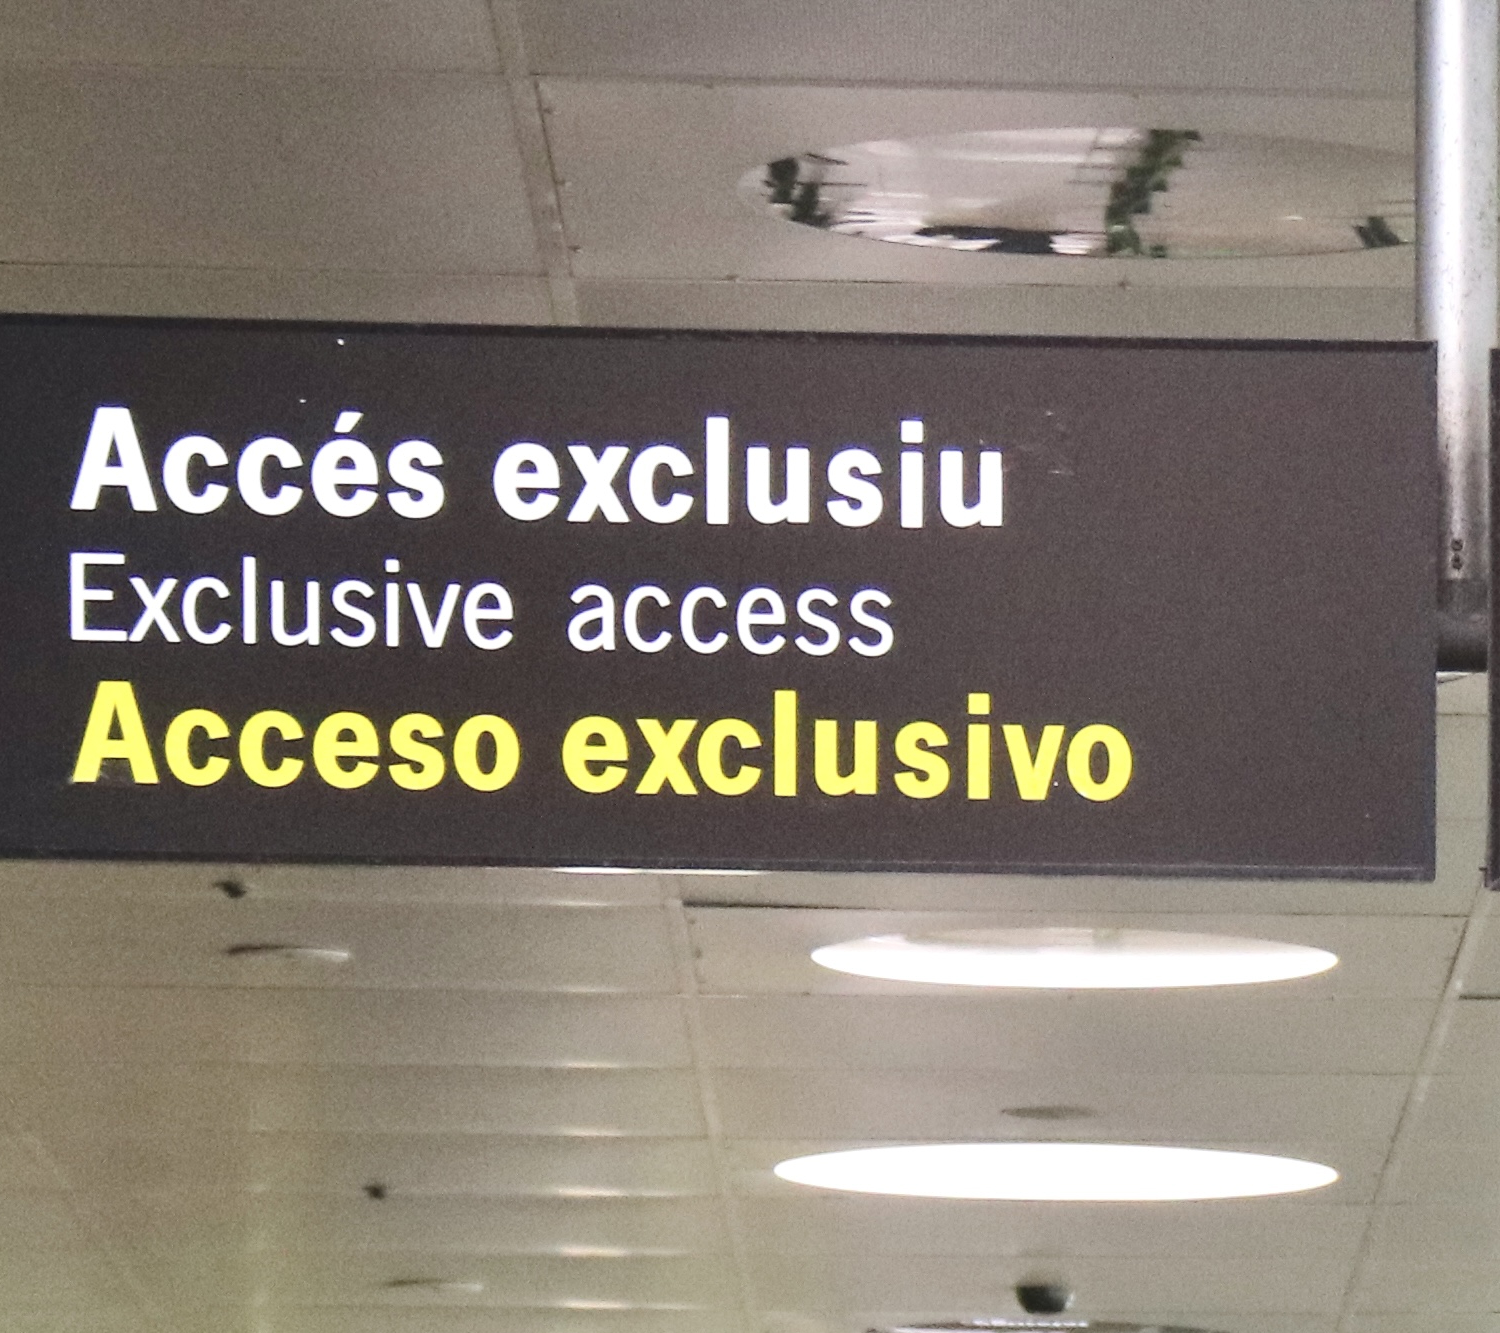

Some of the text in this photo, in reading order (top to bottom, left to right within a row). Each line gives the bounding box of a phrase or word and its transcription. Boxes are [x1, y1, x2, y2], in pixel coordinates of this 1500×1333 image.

[70, 403, 1010, 528] Accés exclusiu
[70, 552, 893, 656] Exclusive access
[72, 681, 1132, 801] Acceso exclusivo
